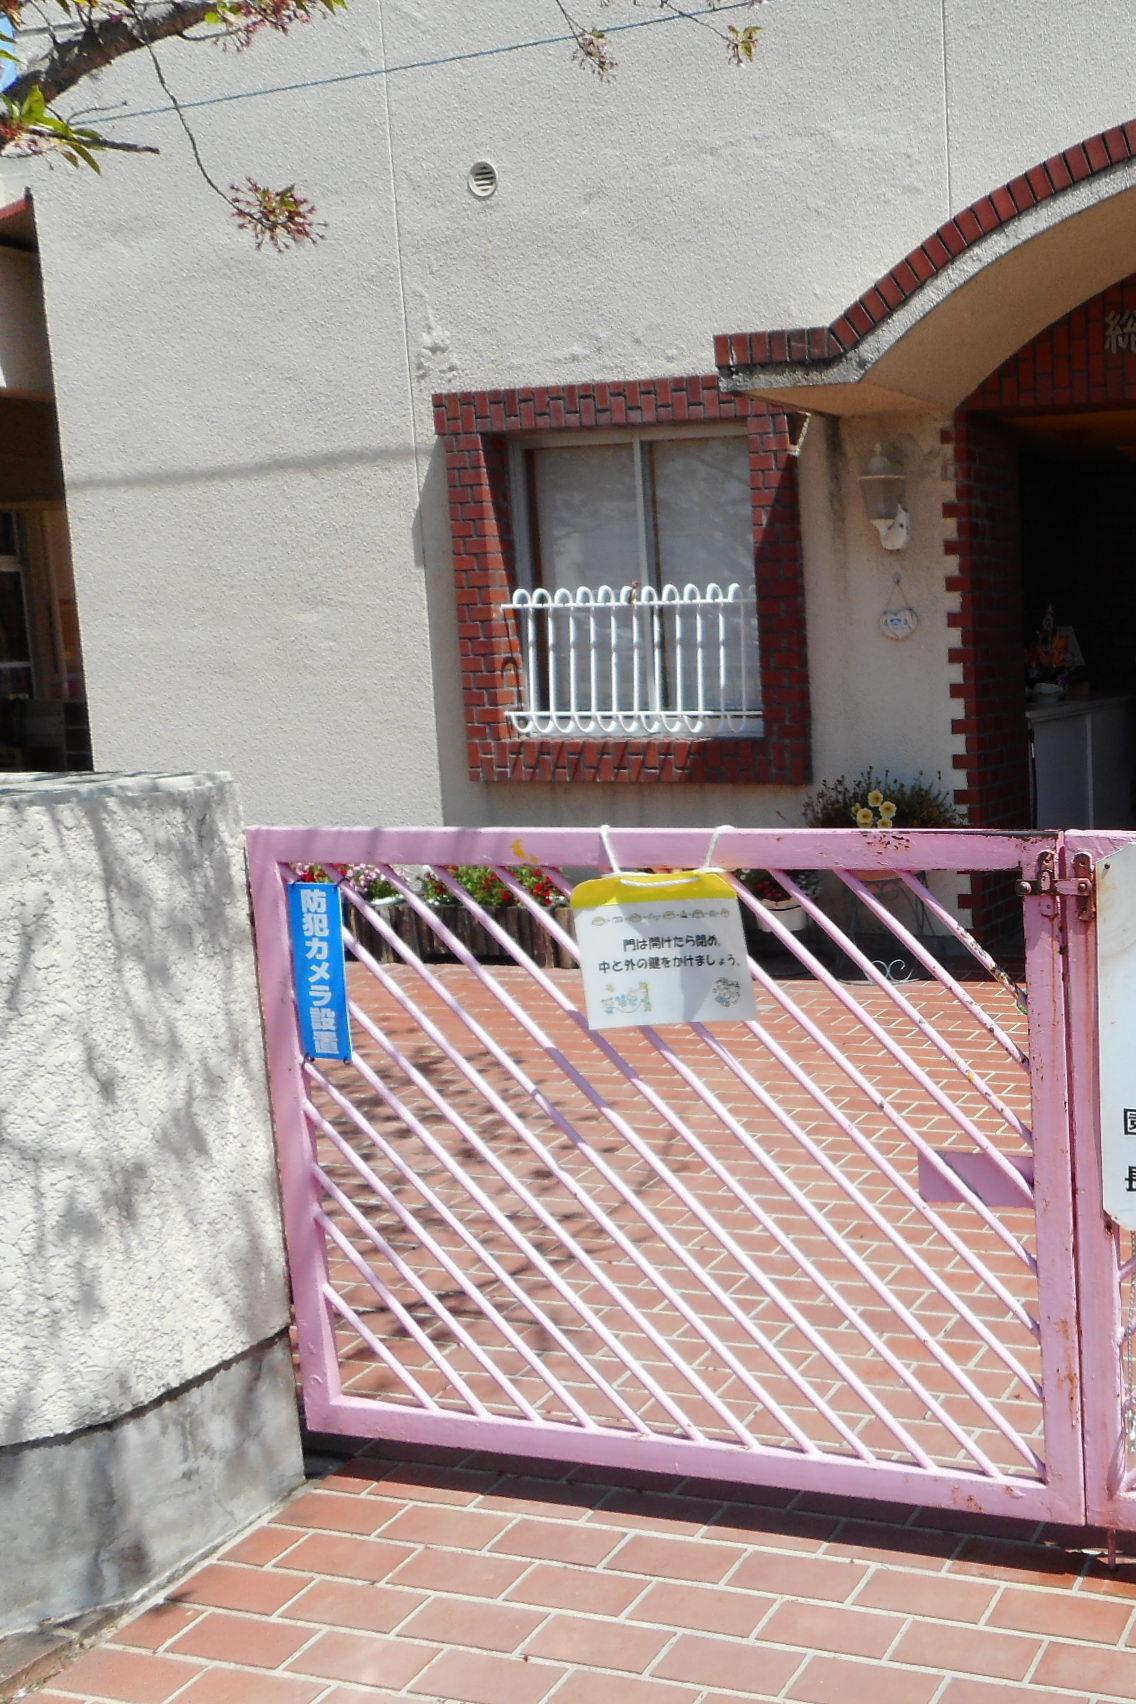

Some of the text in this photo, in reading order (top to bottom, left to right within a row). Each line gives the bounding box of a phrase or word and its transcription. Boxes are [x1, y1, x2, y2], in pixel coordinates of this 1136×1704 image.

[300, 888, 340, 1054] 防犯カメラ設置
